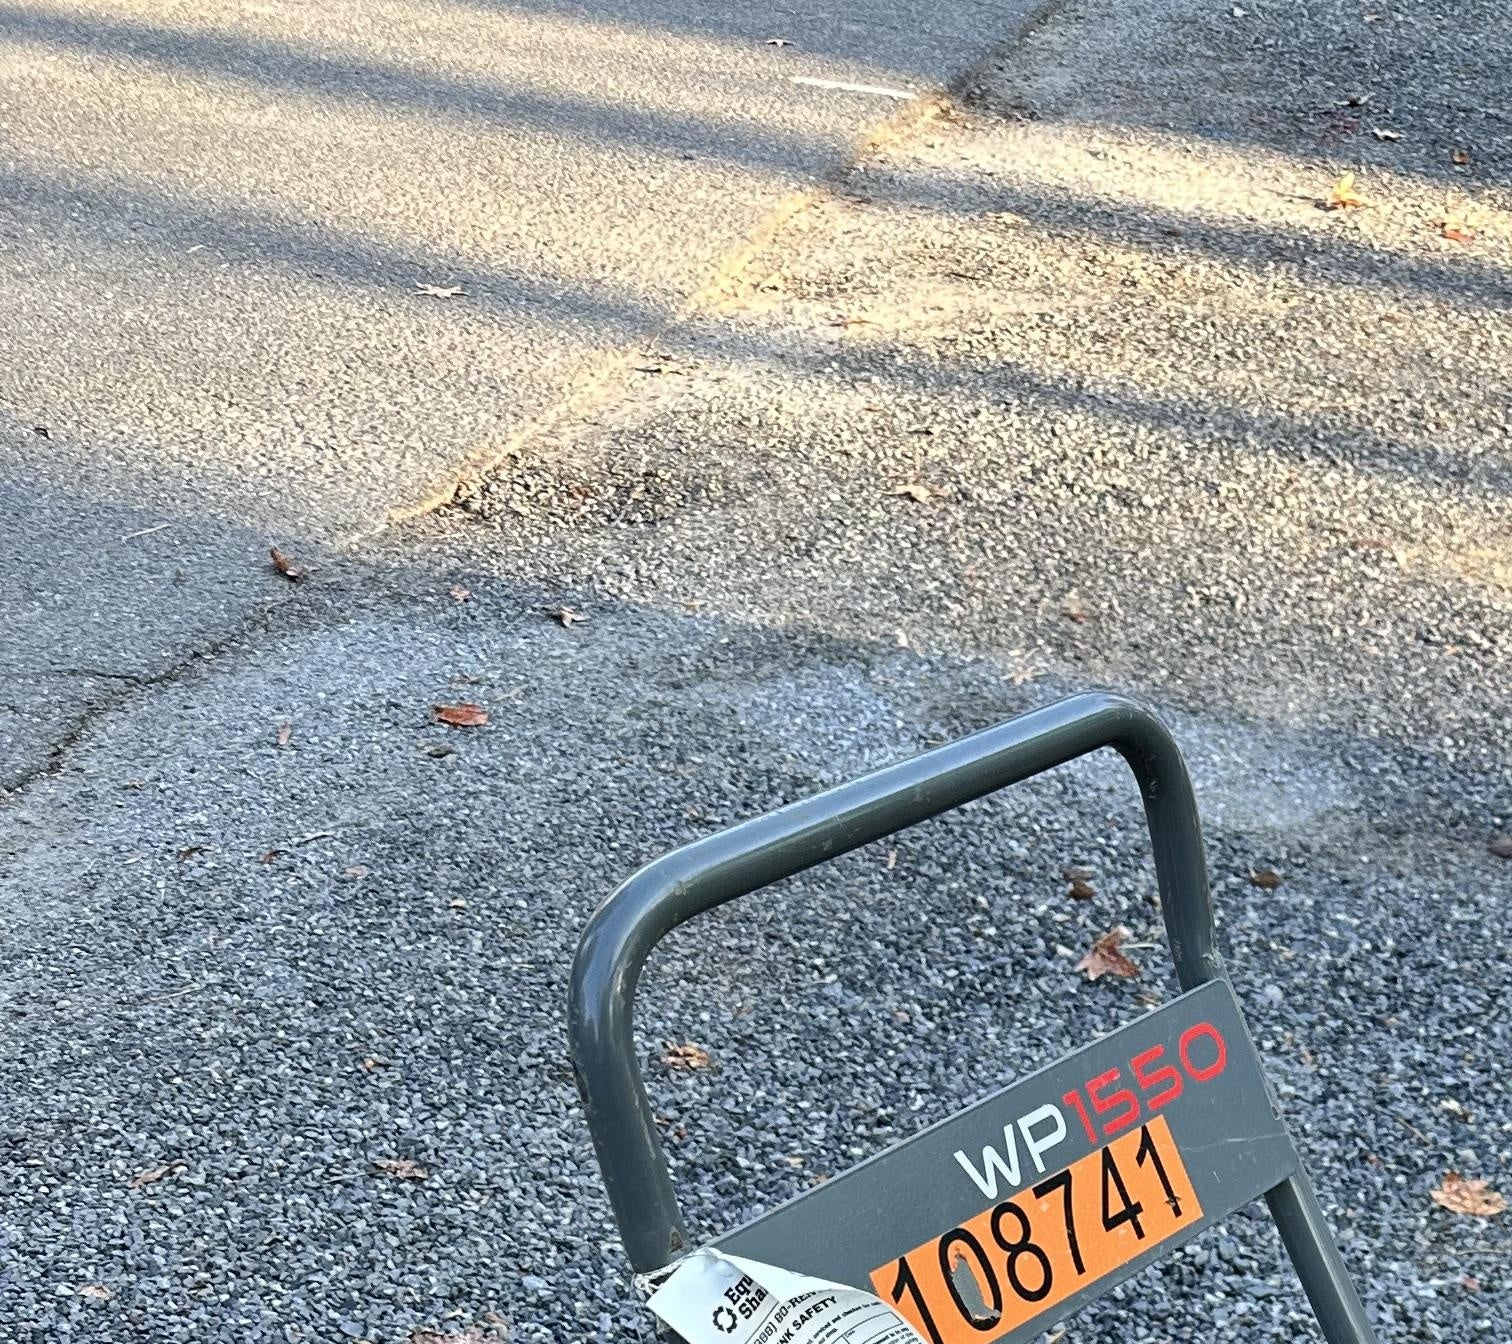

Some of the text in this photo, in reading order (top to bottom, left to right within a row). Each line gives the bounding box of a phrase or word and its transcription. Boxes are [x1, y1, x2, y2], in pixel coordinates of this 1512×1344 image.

[954, 1022, 1227, 1200] WP1550
[724, 1274, 754, 1305] Equ
[738, 1286, 769, 1320] Sha
[792, 1295, 838, 1331] SAFETY
